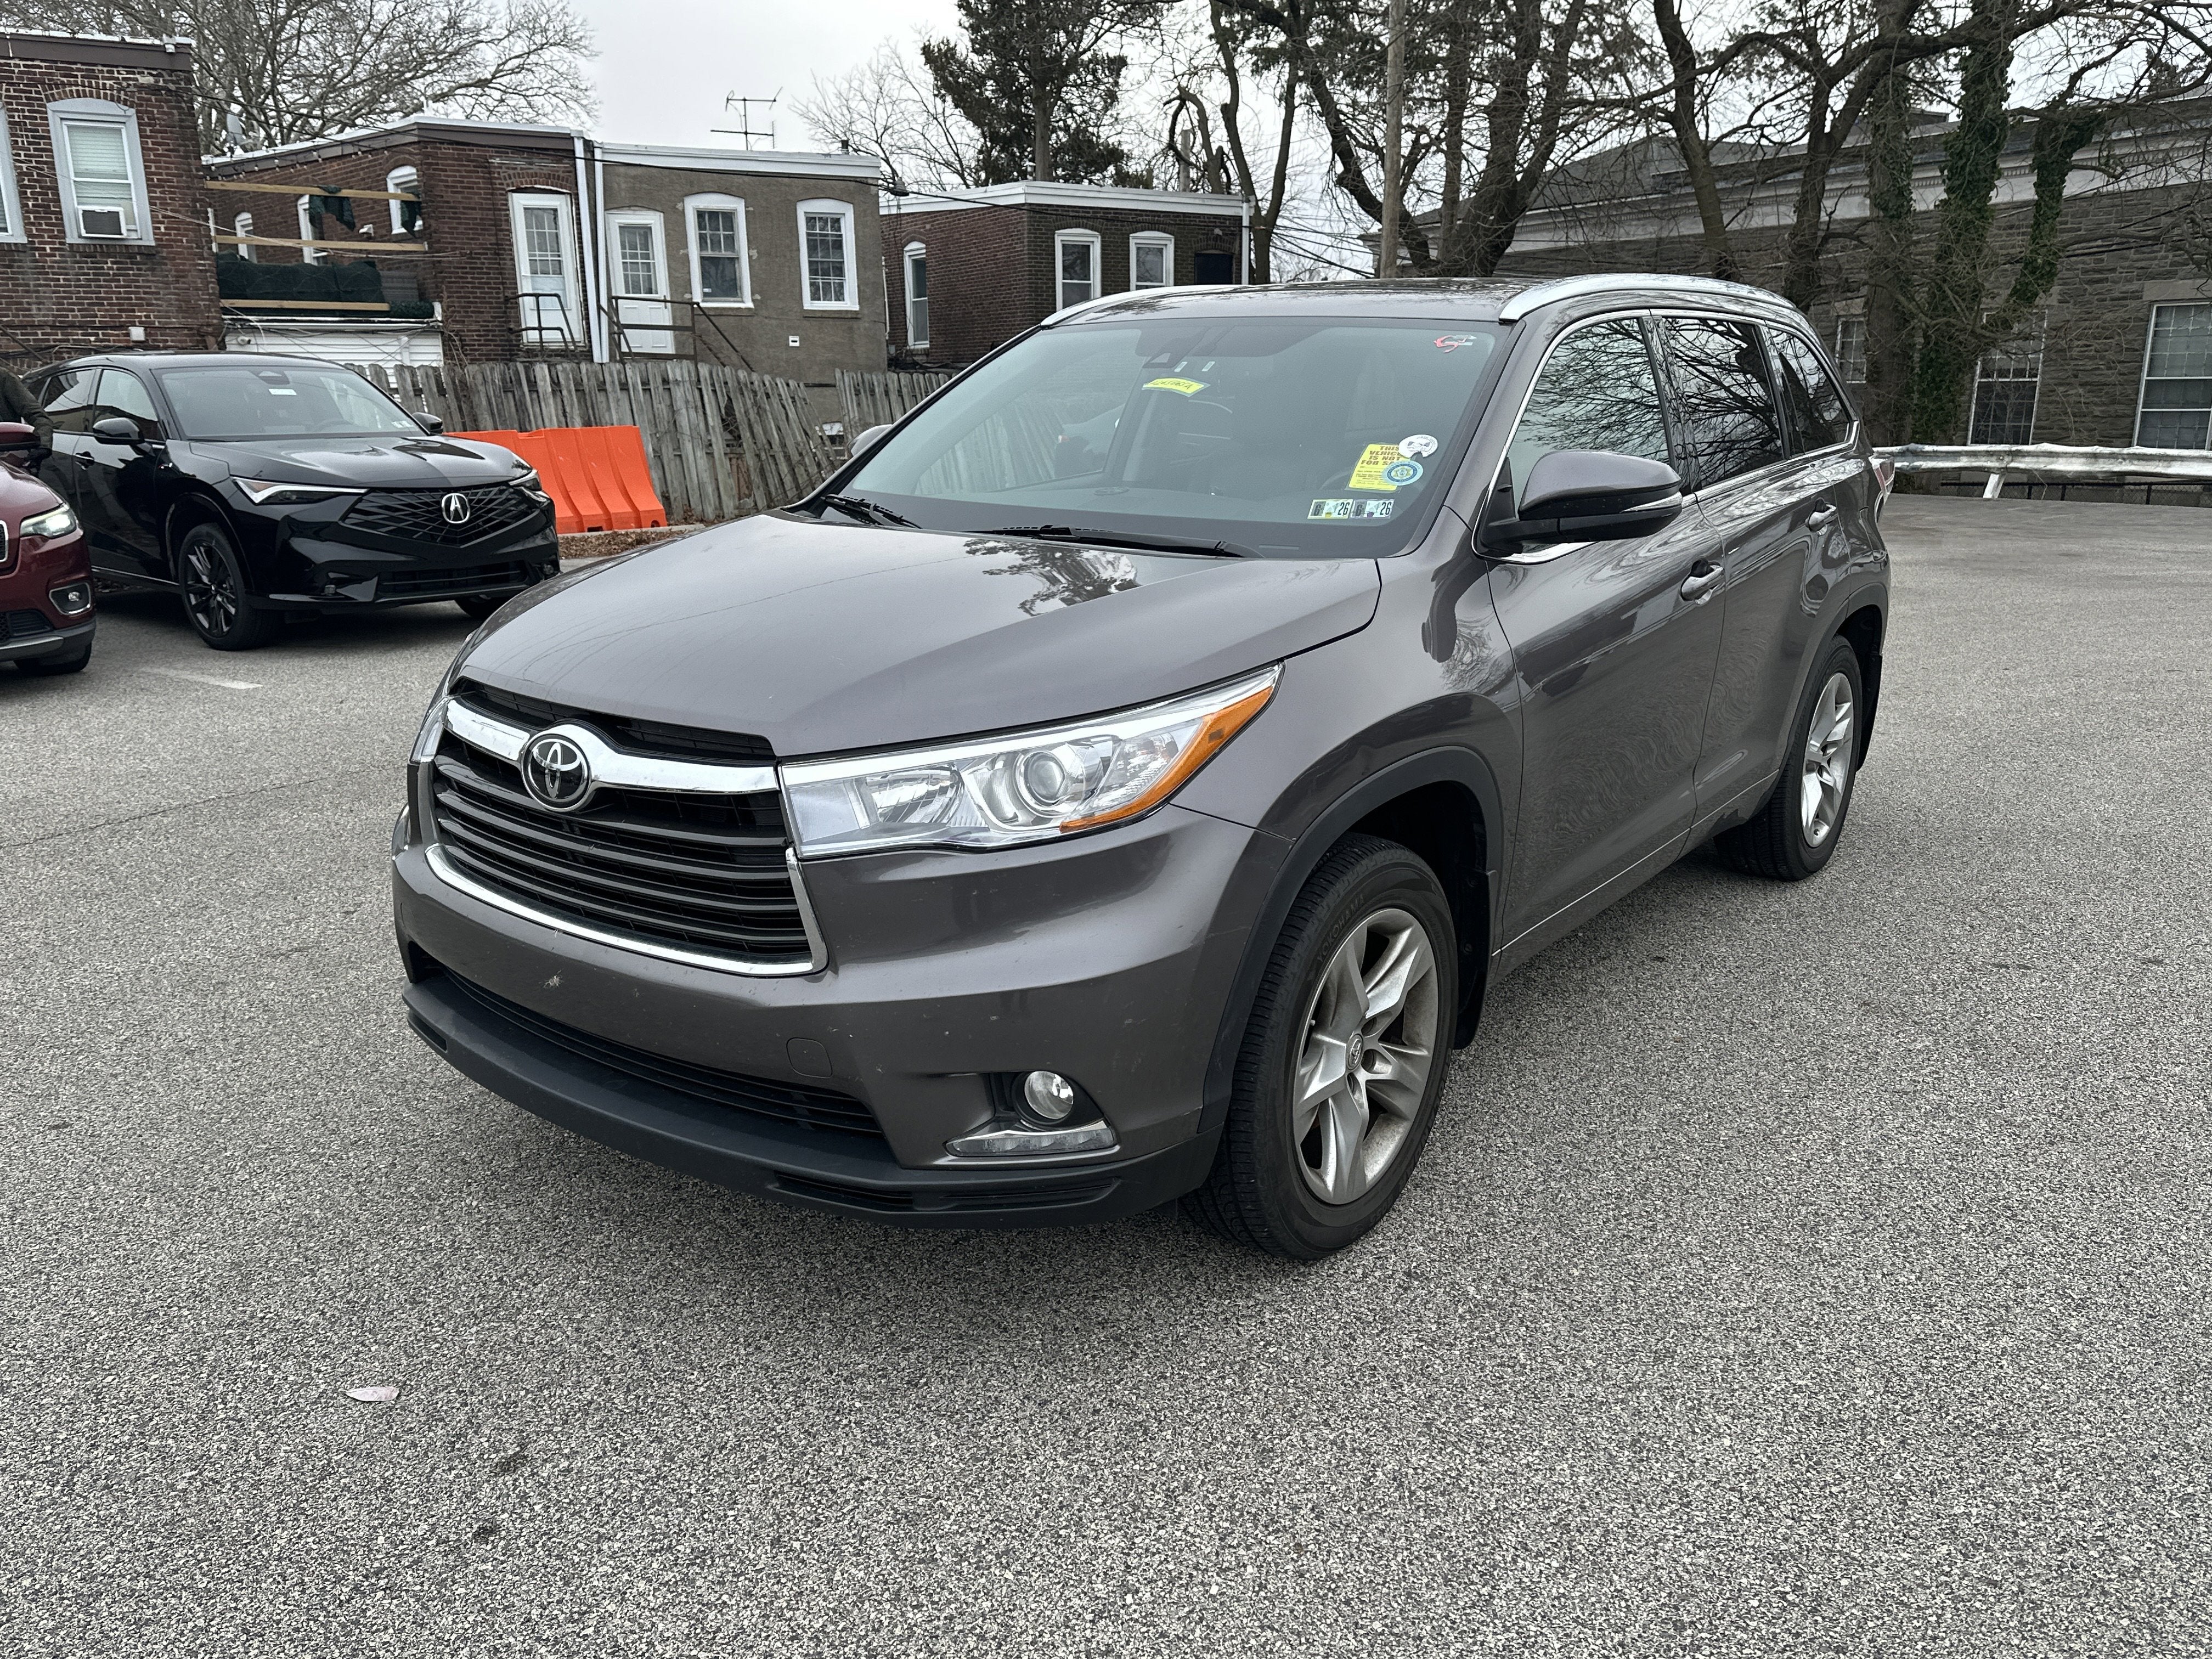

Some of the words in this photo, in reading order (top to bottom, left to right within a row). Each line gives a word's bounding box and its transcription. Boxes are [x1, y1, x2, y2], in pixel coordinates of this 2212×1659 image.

[1313, 504, 1322, 516] 6
[1338, 502, 1350, 516] 26
[1355, 504, 1363, 517] 6
[1380, 501, 1392, 516] 26
[1317, 893, 1365, 962] YOKOHAMA
